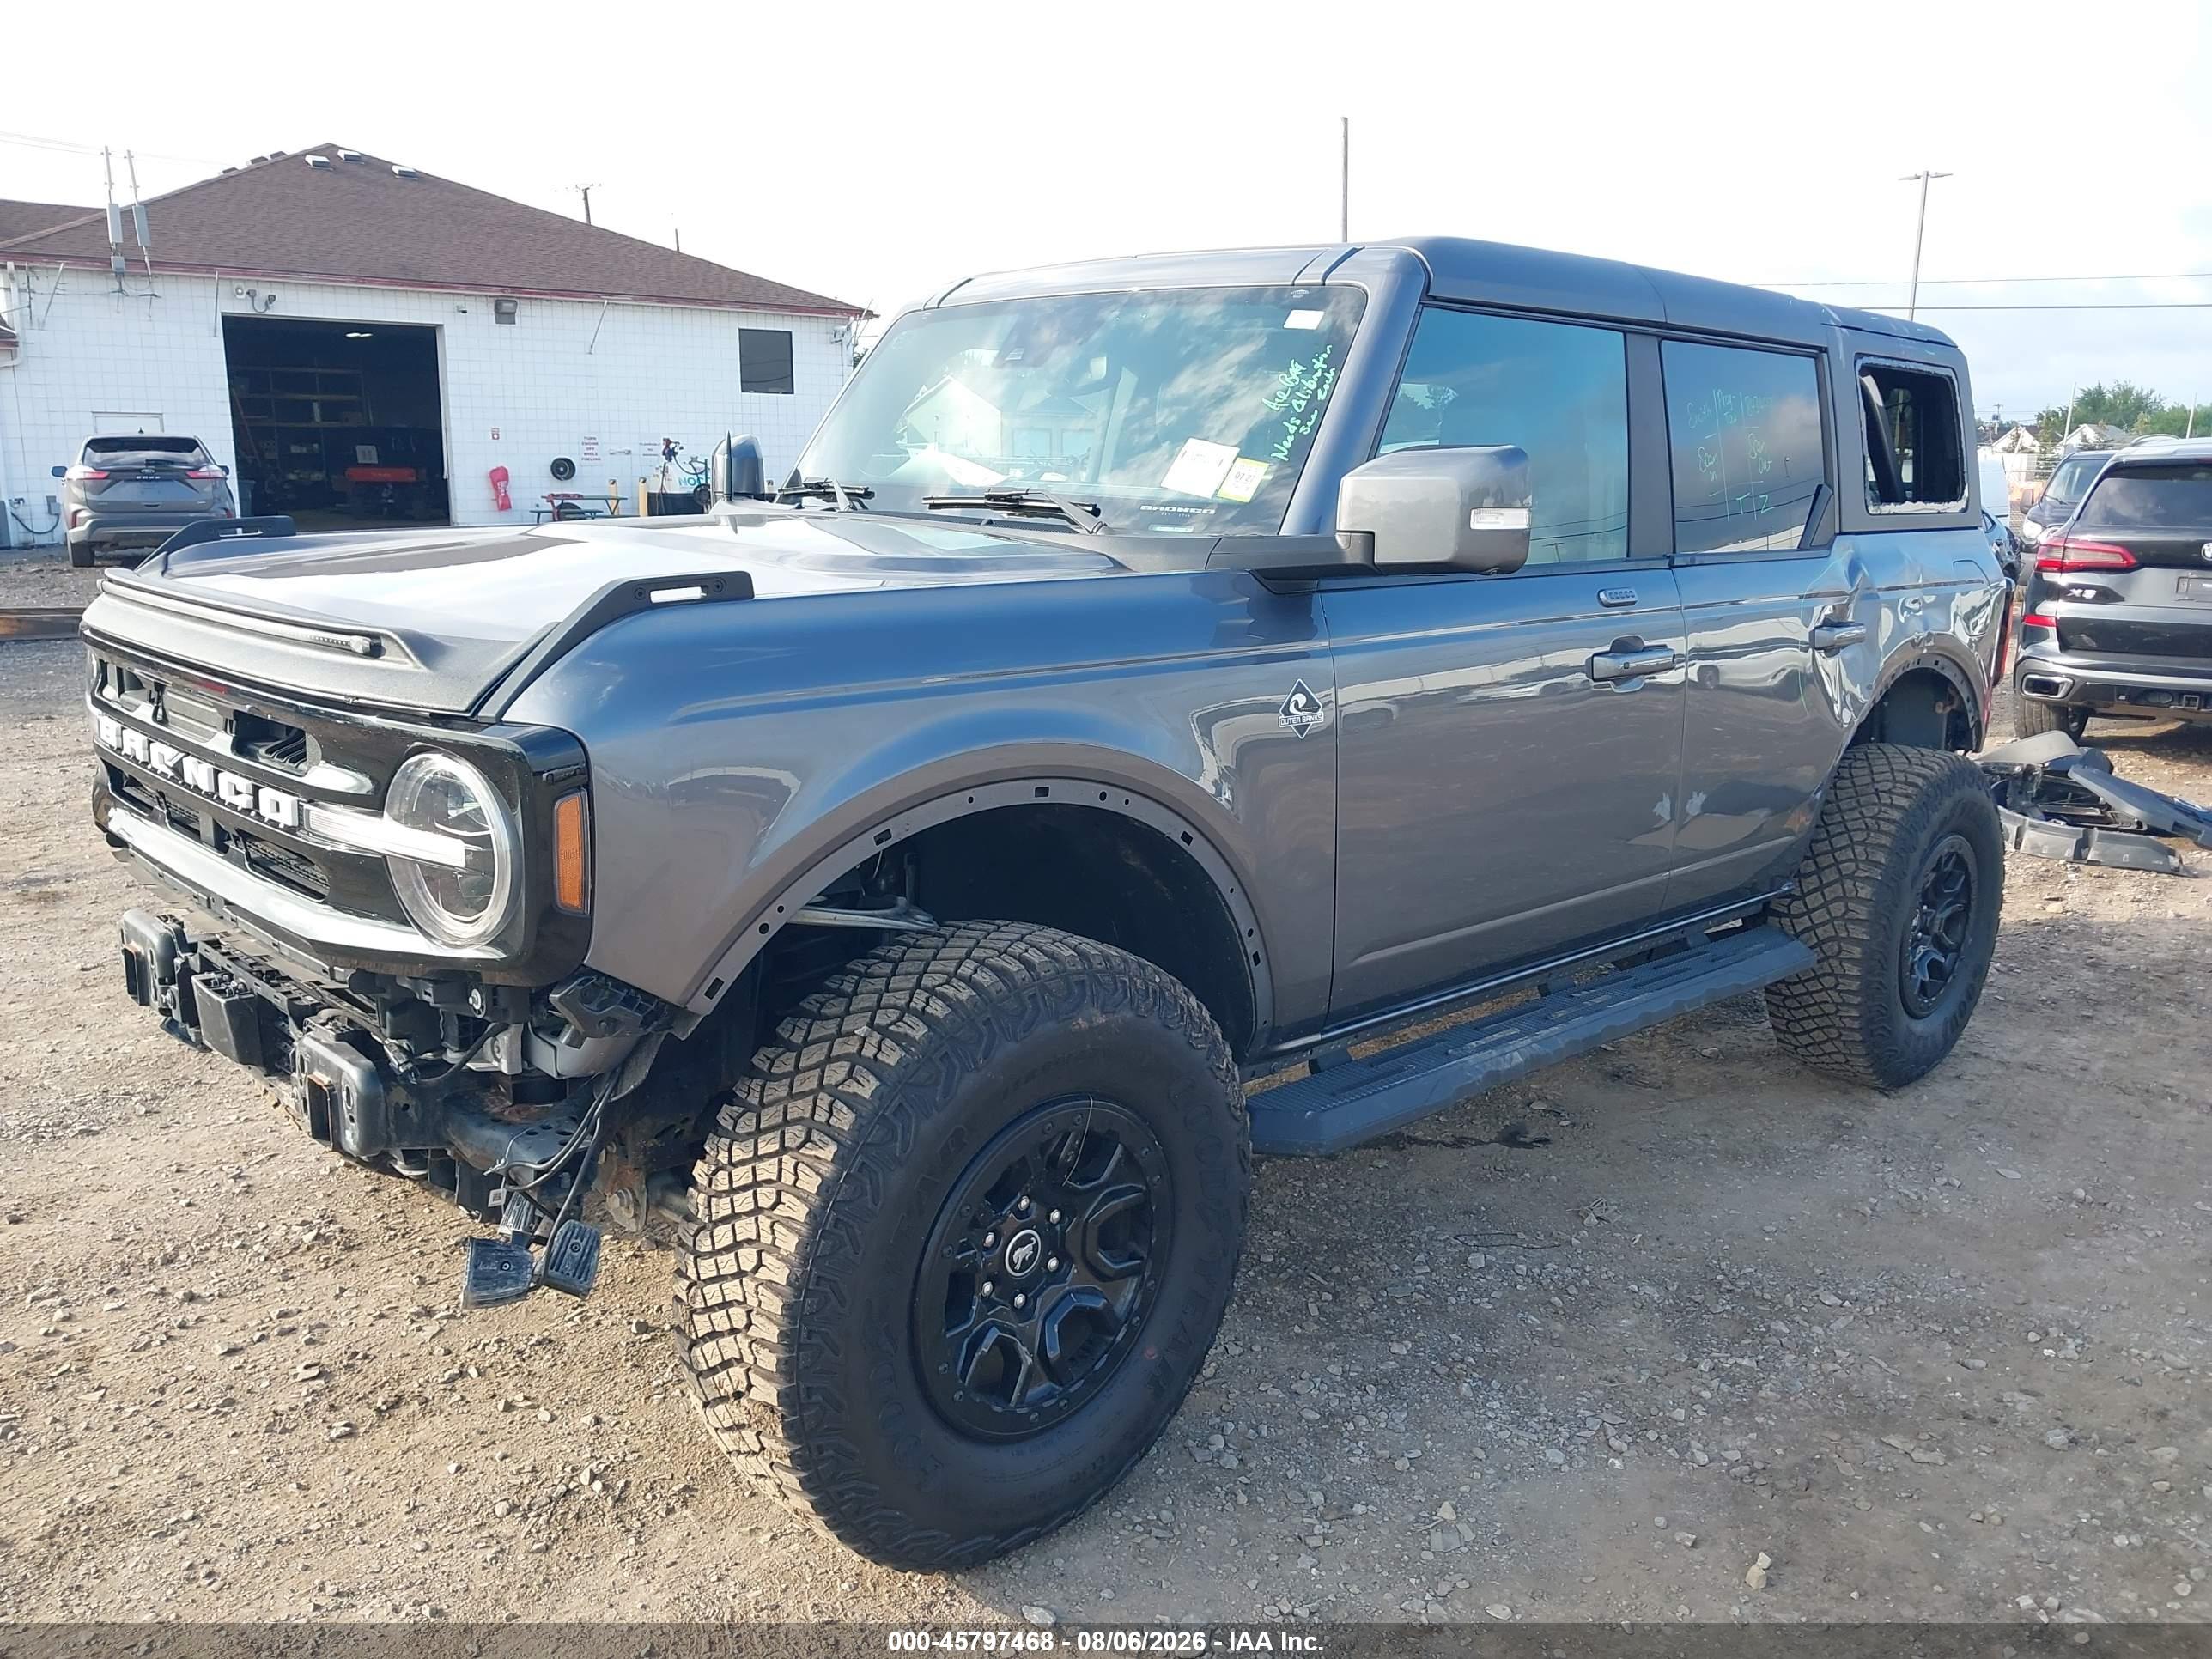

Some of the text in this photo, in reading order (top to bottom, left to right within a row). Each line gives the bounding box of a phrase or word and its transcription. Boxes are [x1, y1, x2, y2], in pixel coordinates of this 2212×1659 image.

[1271, 416, 1301, 461] Needs
[1139, 505, 1216, 514] BRONCO
[1280, 714, 1322, 726] OUTER BANKS
